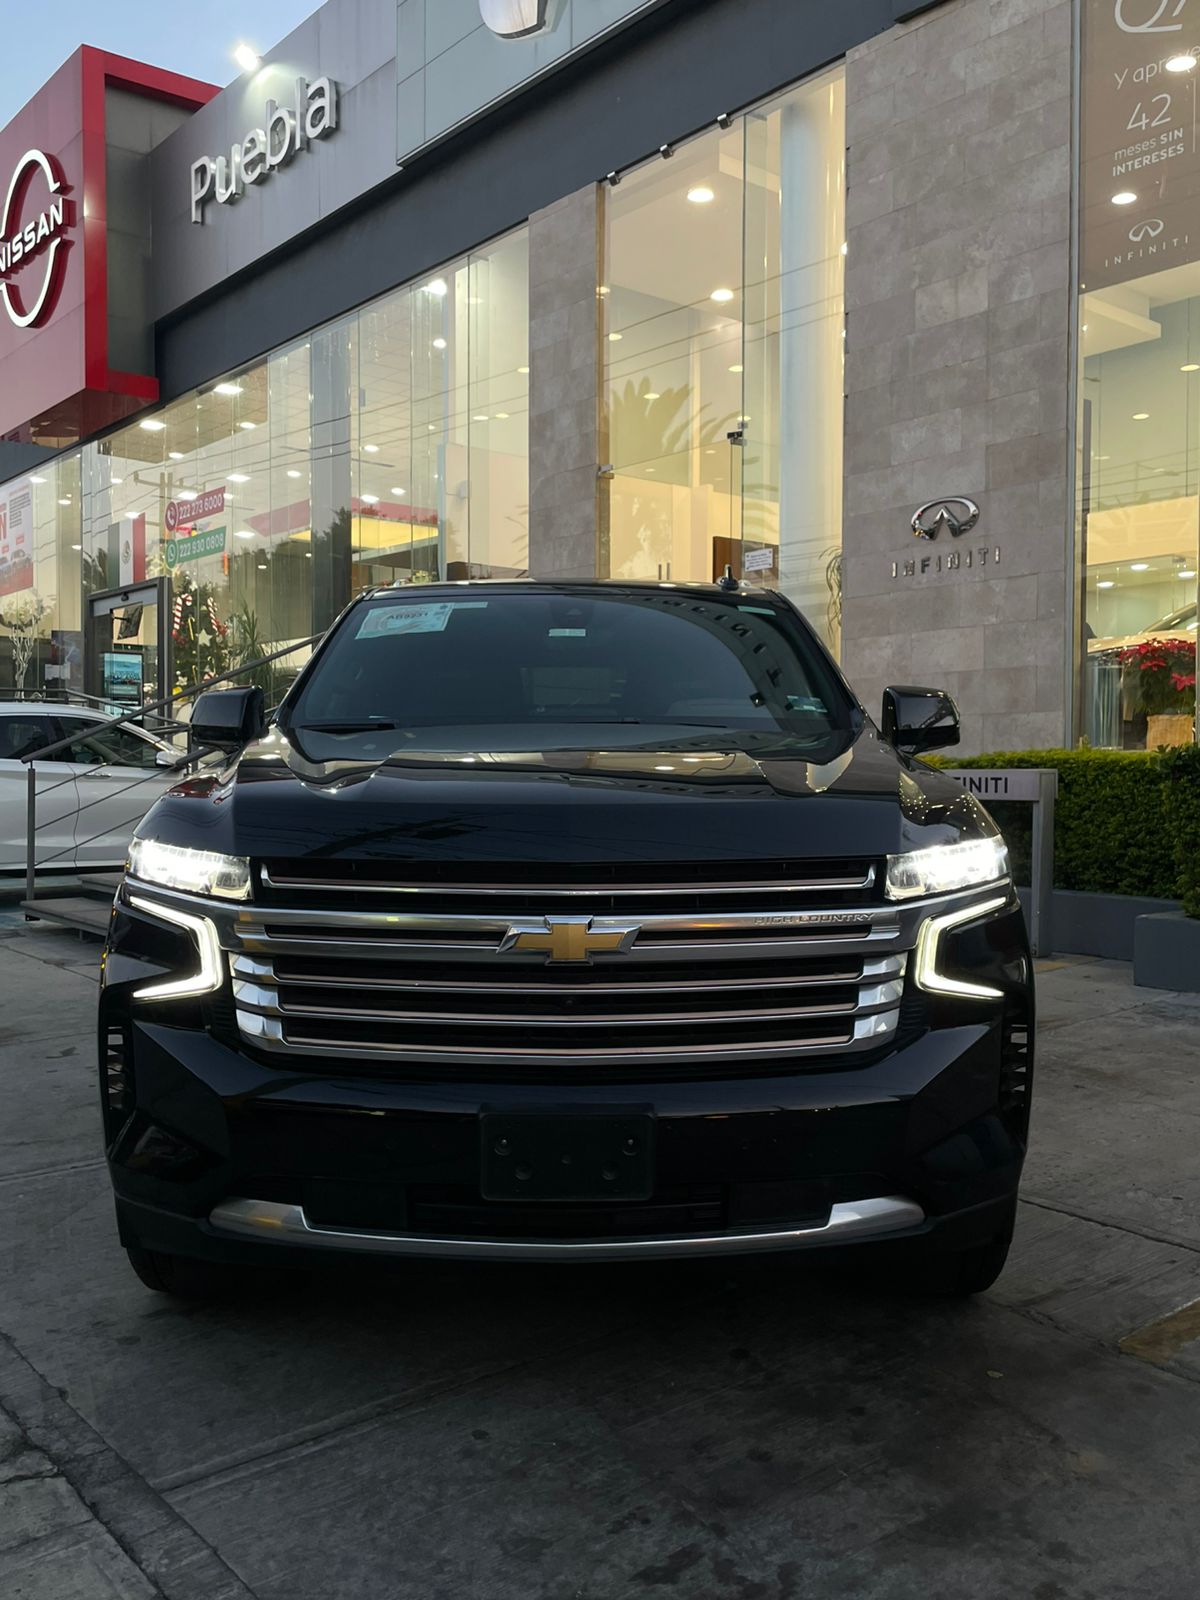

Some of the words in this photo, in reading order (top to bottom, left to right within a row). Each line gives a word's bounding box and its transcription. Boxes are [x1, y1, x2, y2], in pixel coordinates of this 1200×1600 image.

[1126, 93, 1171, 130] 42
[190, 76, 340, 225] Puebla
[1112, 143, 1184, 177] INTERESES
[1114, 137, 1157, 161] meses
[1160, 127, 1183, 144] SIN
[0, 197, 63, 272] NISSAN
[1105, 234, 1189, 268] INFINITI
[179, 504, 191, 520] 222
[191, 499, 203, 516] 273
[203, 493, 223, 511] 6000
[179, 543, 191, 557] 222
[891, 547, 1001, 578] INFINITI
[753, 914, 793, 925] HIGH
[799, 912, 875, 924] COUNTRY
